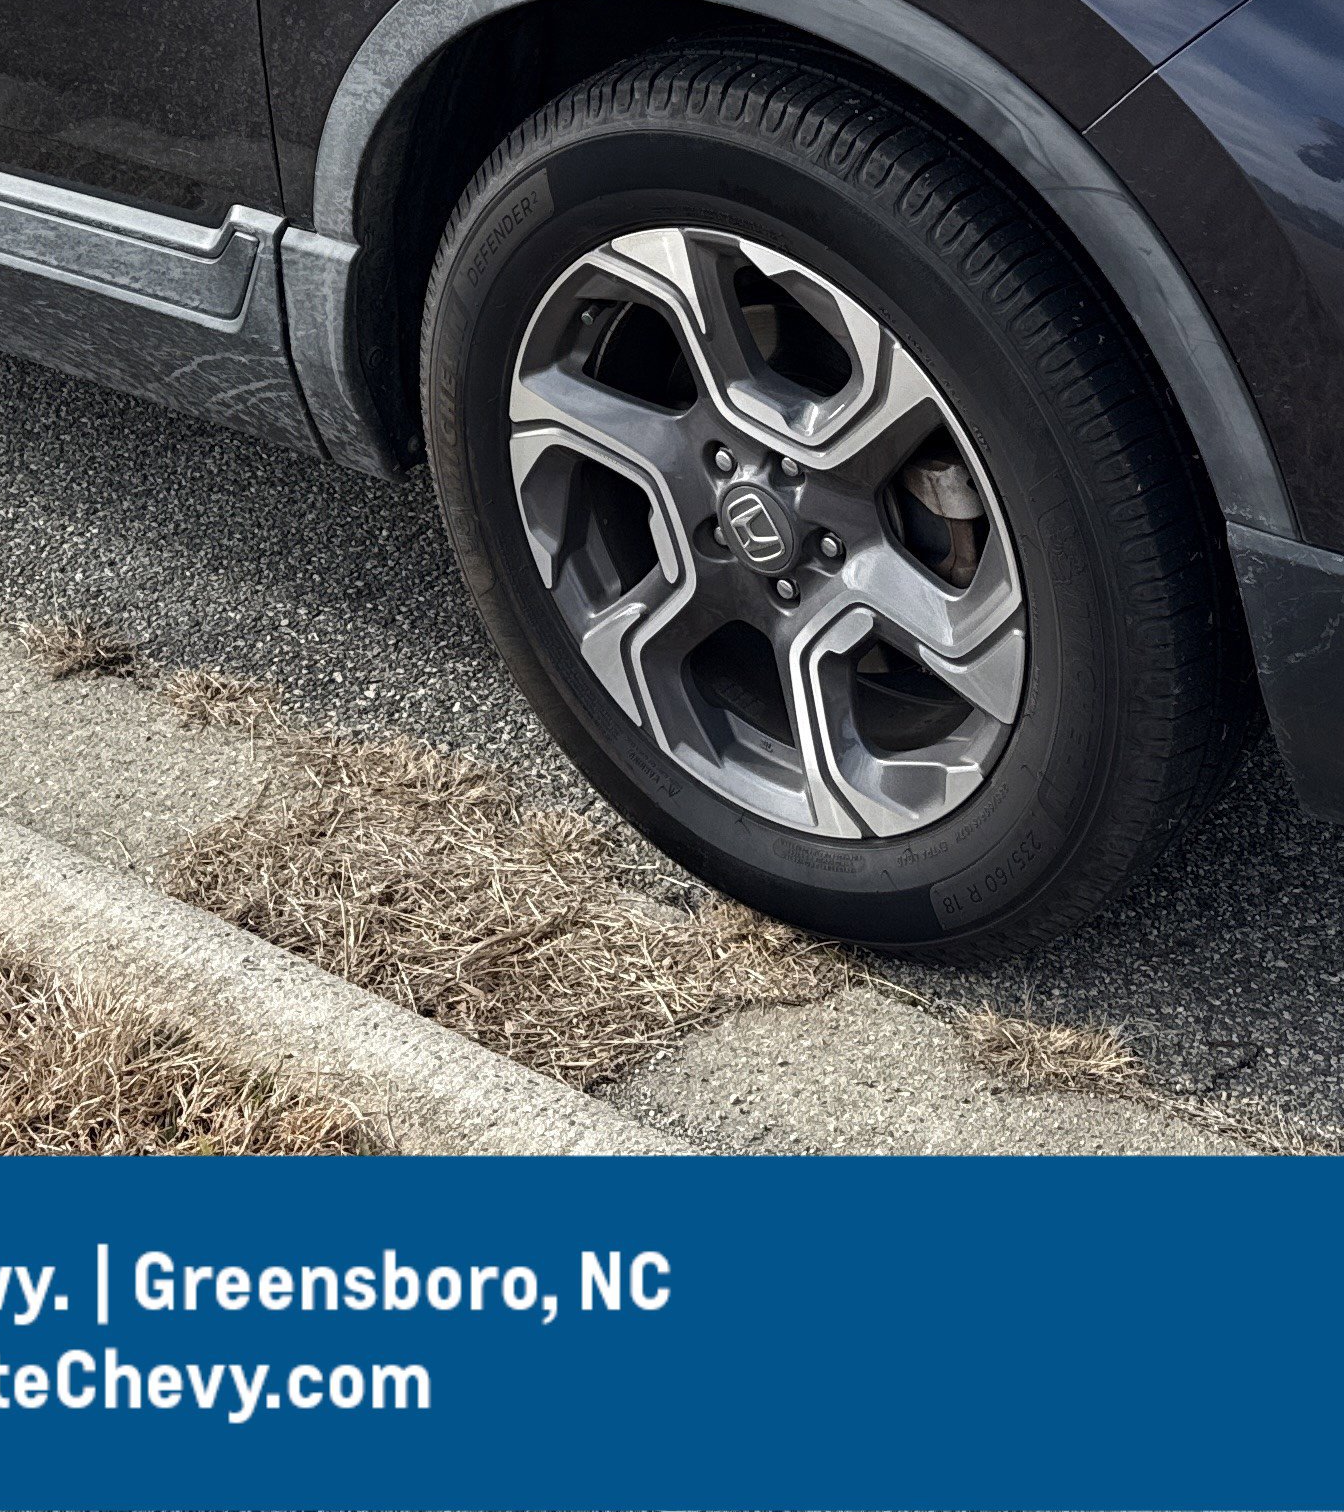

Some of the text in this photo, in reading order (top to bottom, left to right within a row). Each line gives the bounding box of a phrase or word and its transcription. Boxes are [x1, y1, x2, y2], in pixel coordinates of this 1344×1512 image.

[942, 829, 1043, 915] 235/60 R 18
